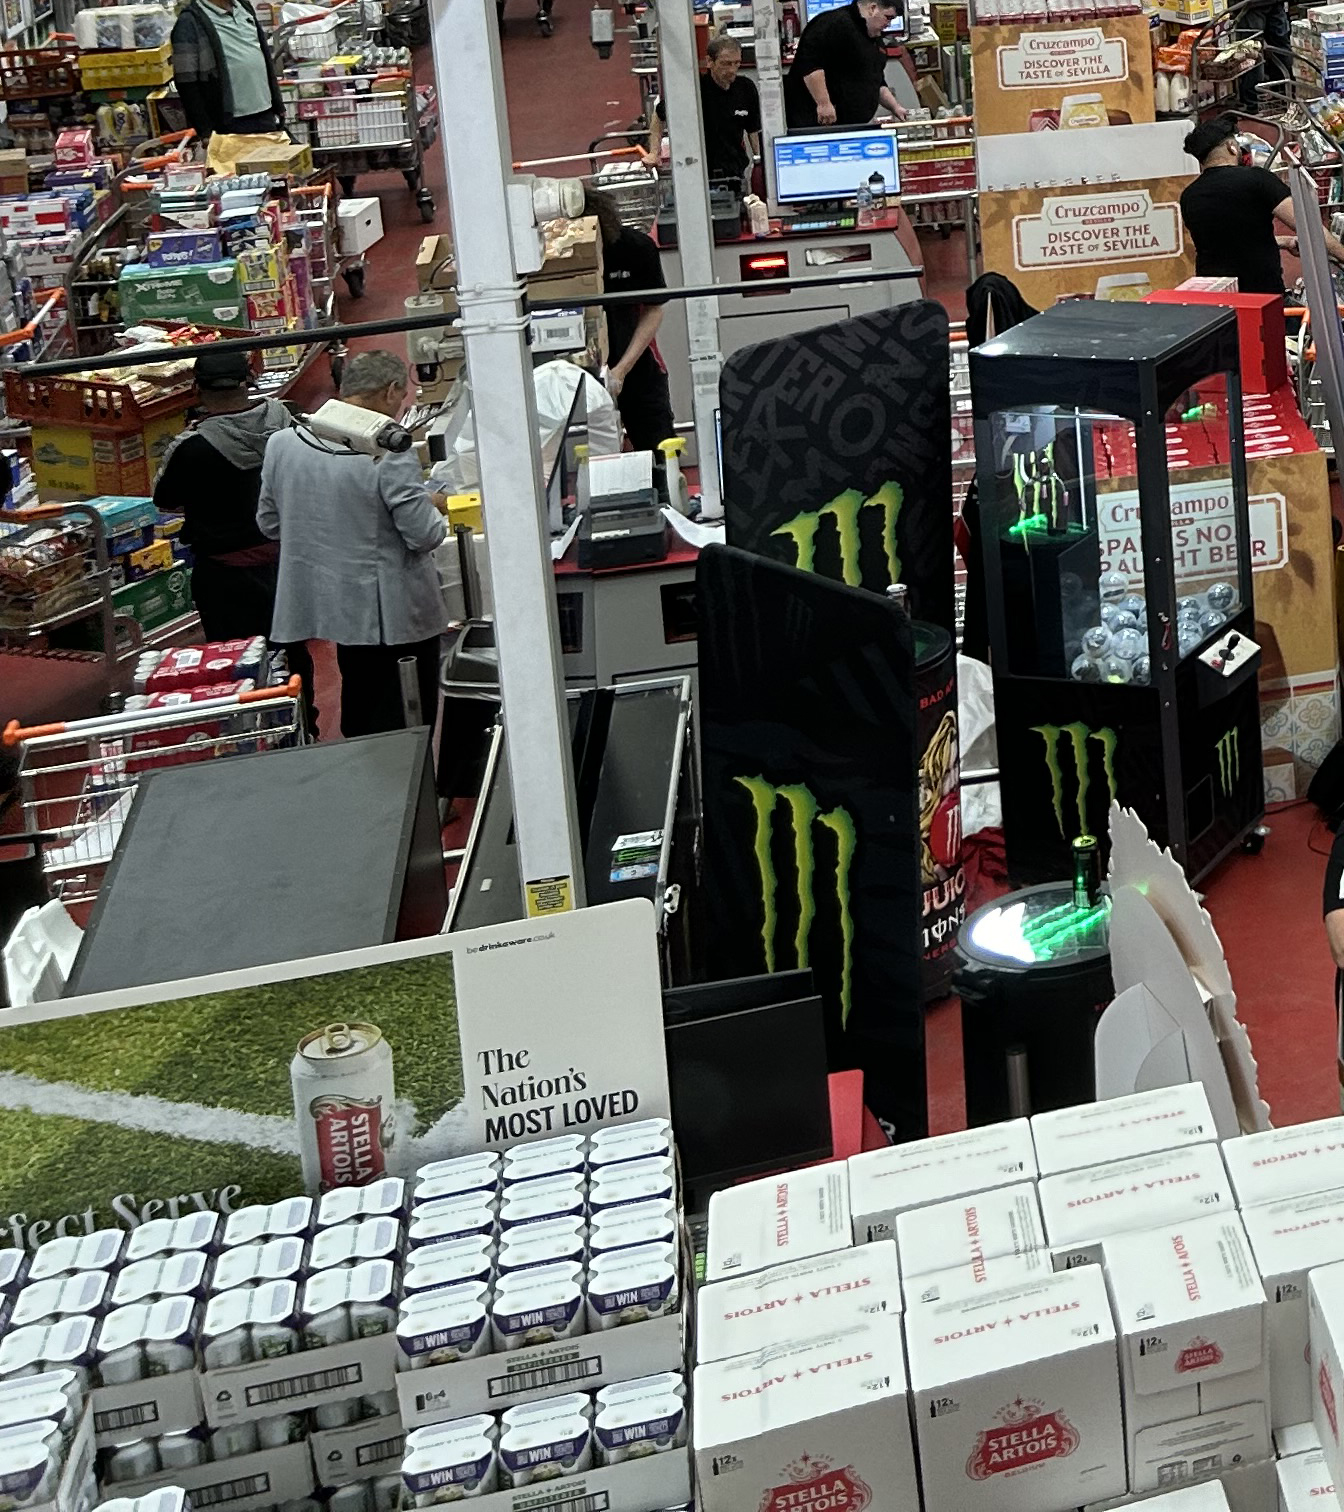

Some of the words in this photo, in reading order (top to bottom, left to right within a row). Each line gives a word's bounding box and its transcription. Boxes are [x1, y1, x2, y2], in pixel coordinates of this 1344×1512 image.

[1024, 58, 1080, 70] DISCOVER
[1083, 55, 1103, 64] THE
[1040, 243, 1084, 257] TASTE
[1103, 237, 1160, 252] SEVILLA
[1048, 227, 1119, 244] DISCOVER
[1123, 224, 1150, 236] THE
[476, 1048, 531, 1076] The
[480, 1067, 587, 1110] Nation's
[485, 1105, 556, 1143] MOST
[562, 1088, 639, 1128] LOVED
[327, 1118, 354, 1187] ARTOIS
[349, 1111, 373, 1184] STELLA
[425, 1332, 448, 1347] WIN
[987, 1423, 1056, 1452] STELLA
[988, 1435, 1058, 1465] ARTOIS
[775, 1479, 848, 1509] STELLA
